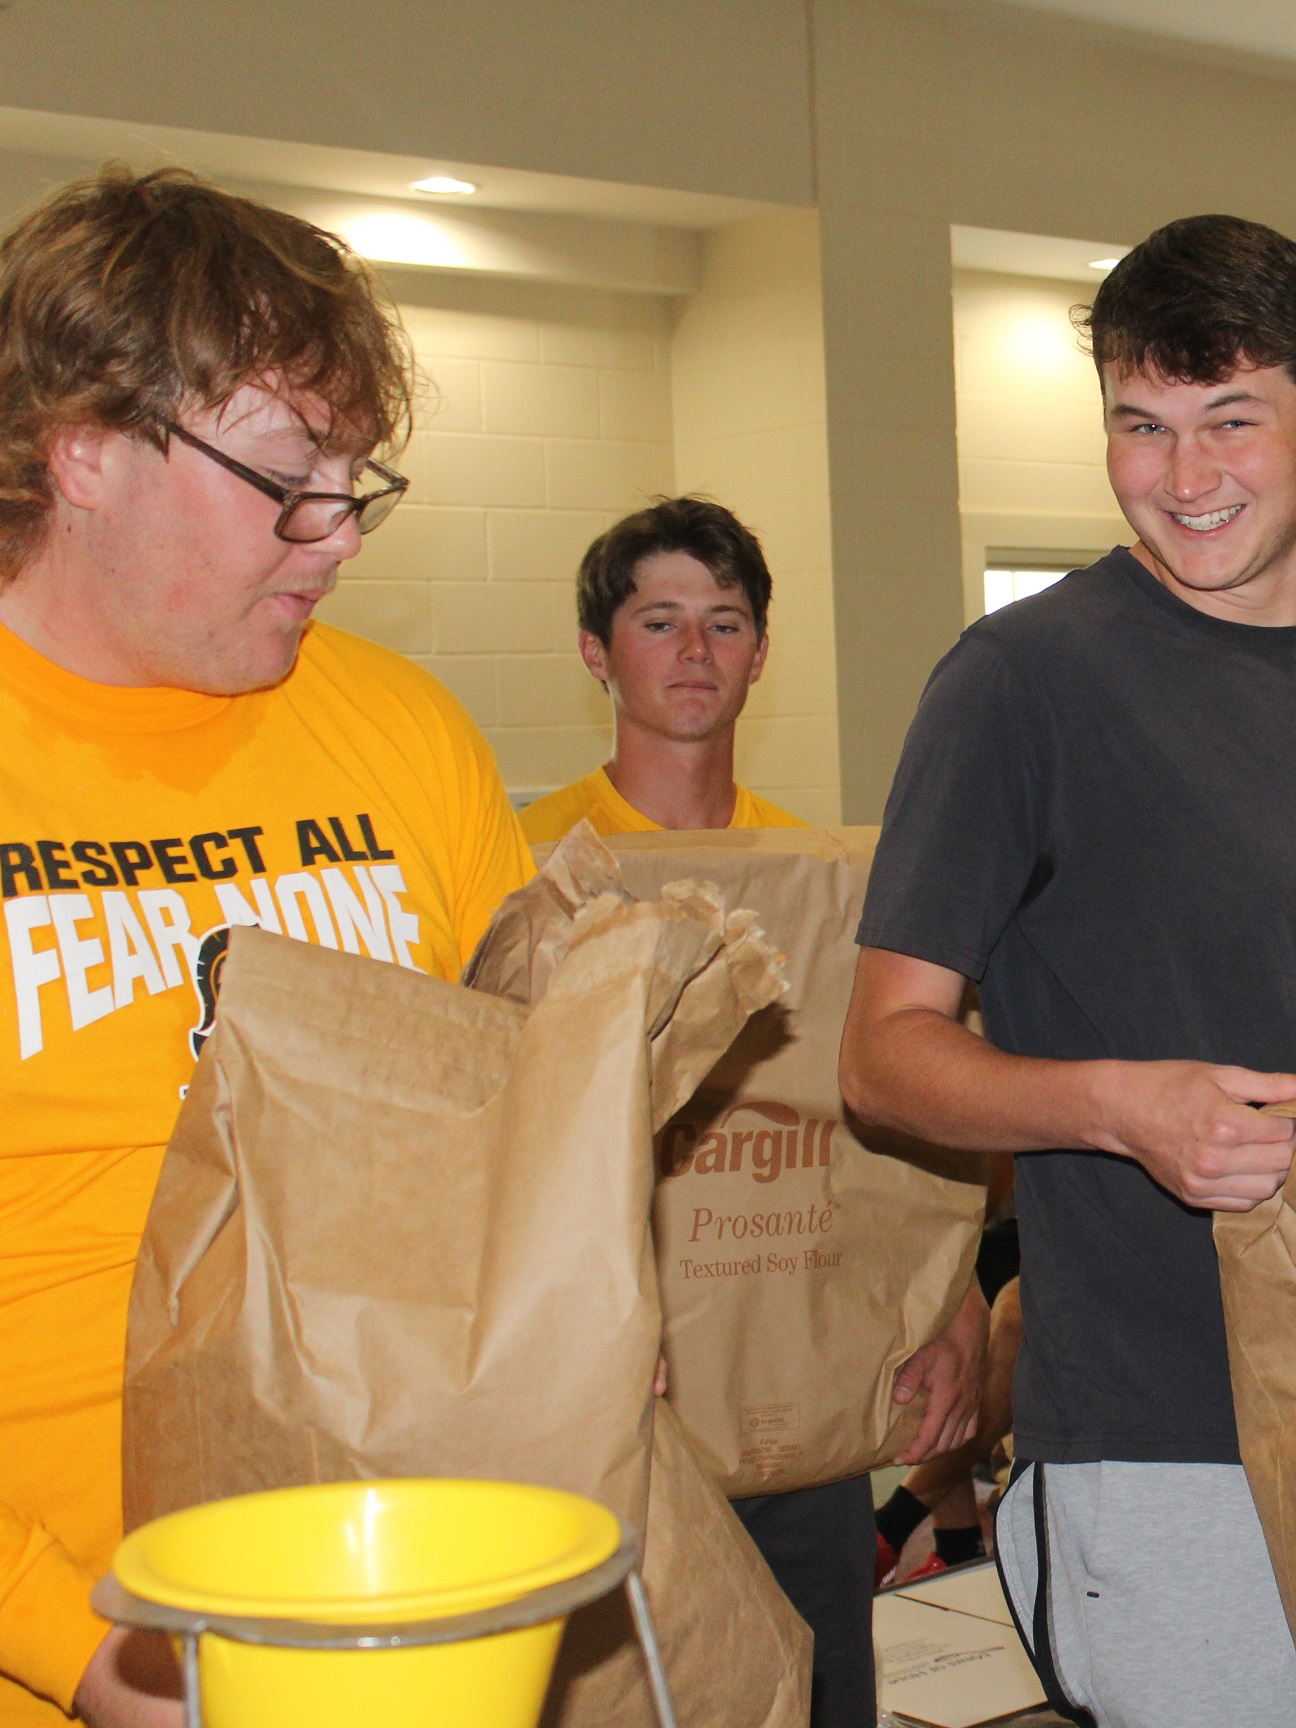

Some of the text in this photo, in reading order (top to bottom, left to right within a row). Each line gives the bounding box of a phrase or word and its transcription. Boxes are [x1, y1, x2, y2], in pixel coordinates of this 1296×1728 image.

[0, 813, 395, 897] RESPECT ALL
[4, 889, 201, 1061] FEAR
[658, 1118, 838, 1184] Cargill
[688, 1200, 835, 1242] Prosanté
[679, 1249, 844, 1280] Textured Soy Flour
